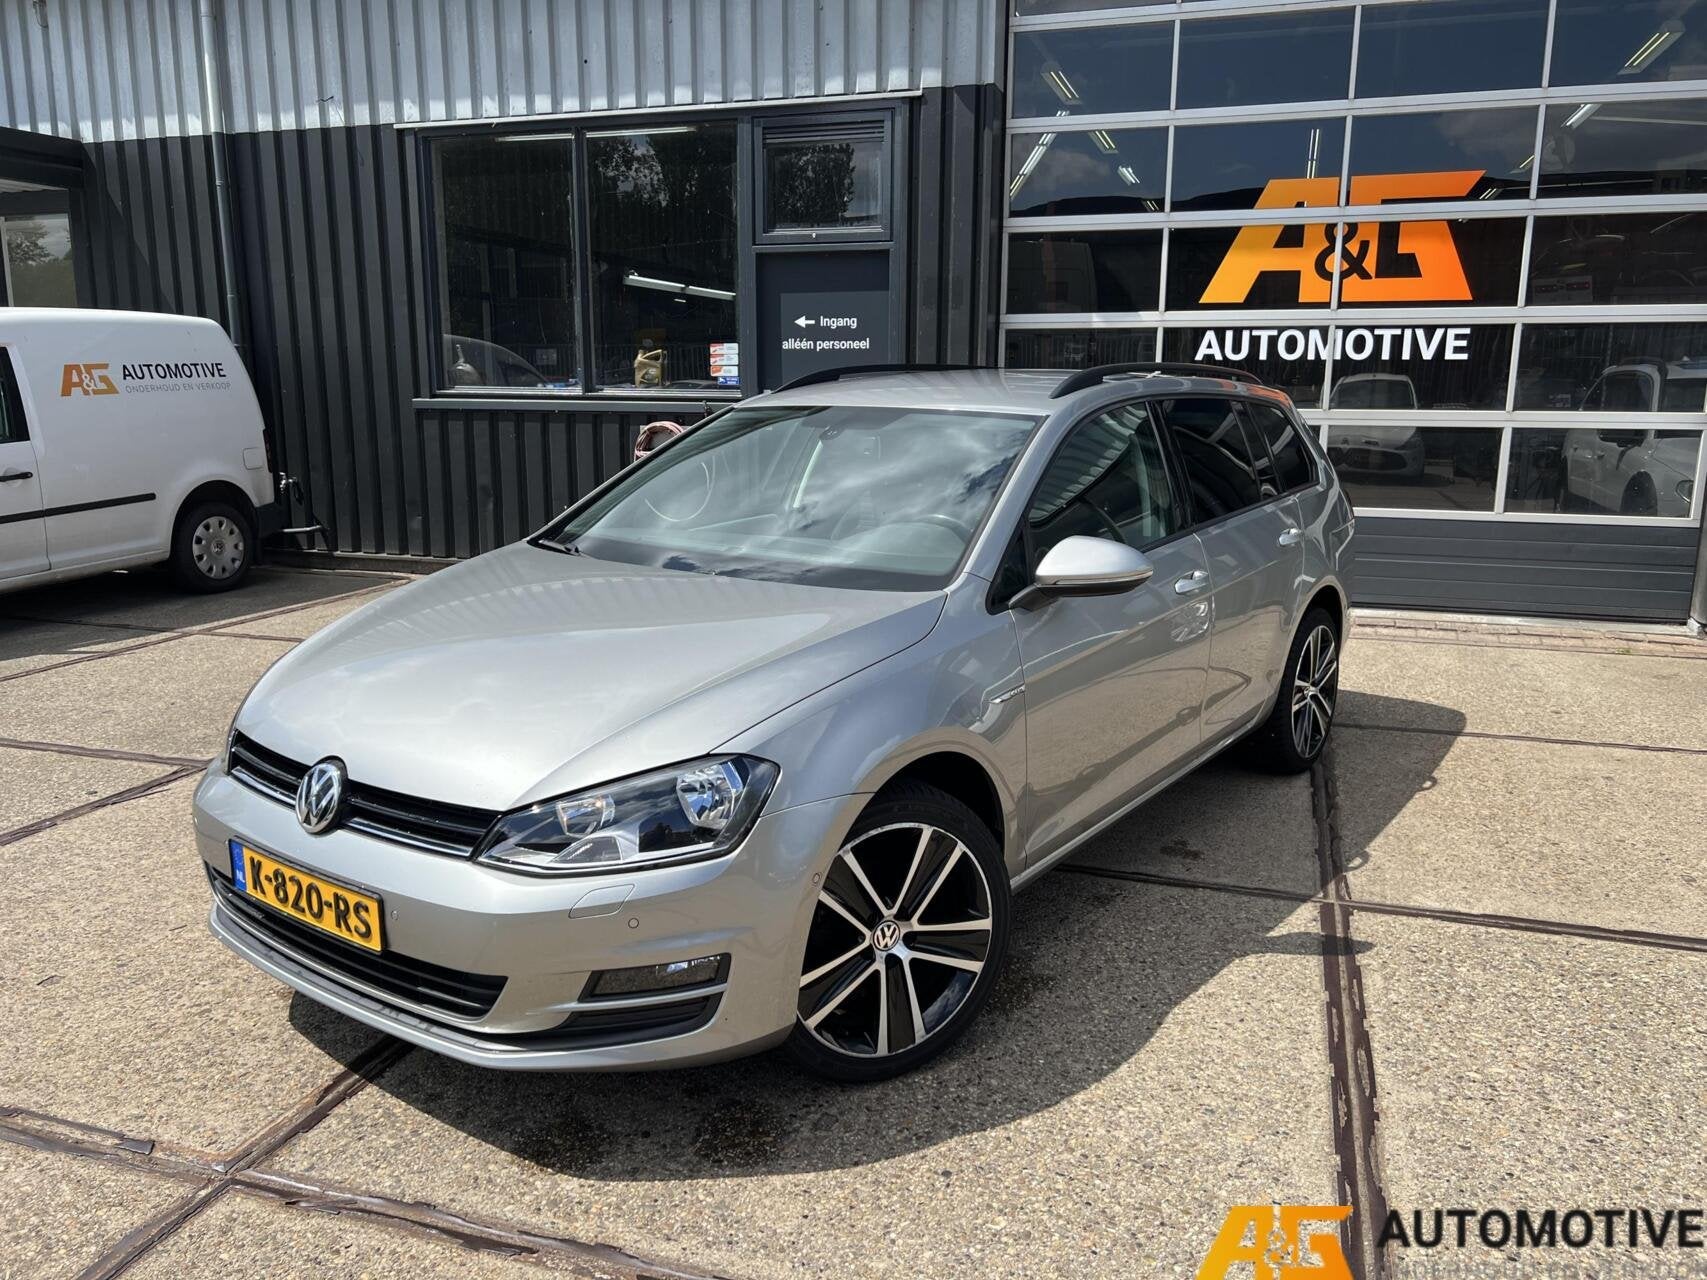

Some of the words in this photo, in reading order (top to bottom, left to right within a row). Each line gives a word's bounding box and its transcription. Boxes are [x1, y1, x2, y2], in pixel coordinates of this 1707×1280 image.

[1199, 170, 1487, 303] A&G
[820, 315, 858, 329] Ingang
[782, 338, 814, 350] alléén
[816, 337, 870, 352] personeel
[1194, 327, 1472, 361] AUTOMOTIVE
[61, 363, 120, 397] A&G
[122, 362, 227, 381] AUTOMOTIVE
[125, 382, 181, 394] ONDERHOUD
[183, 382, 194, 392] EN
[196, 381, 232, 392] VERKOOP
[249, 855, 372, 939] K-820-RS
